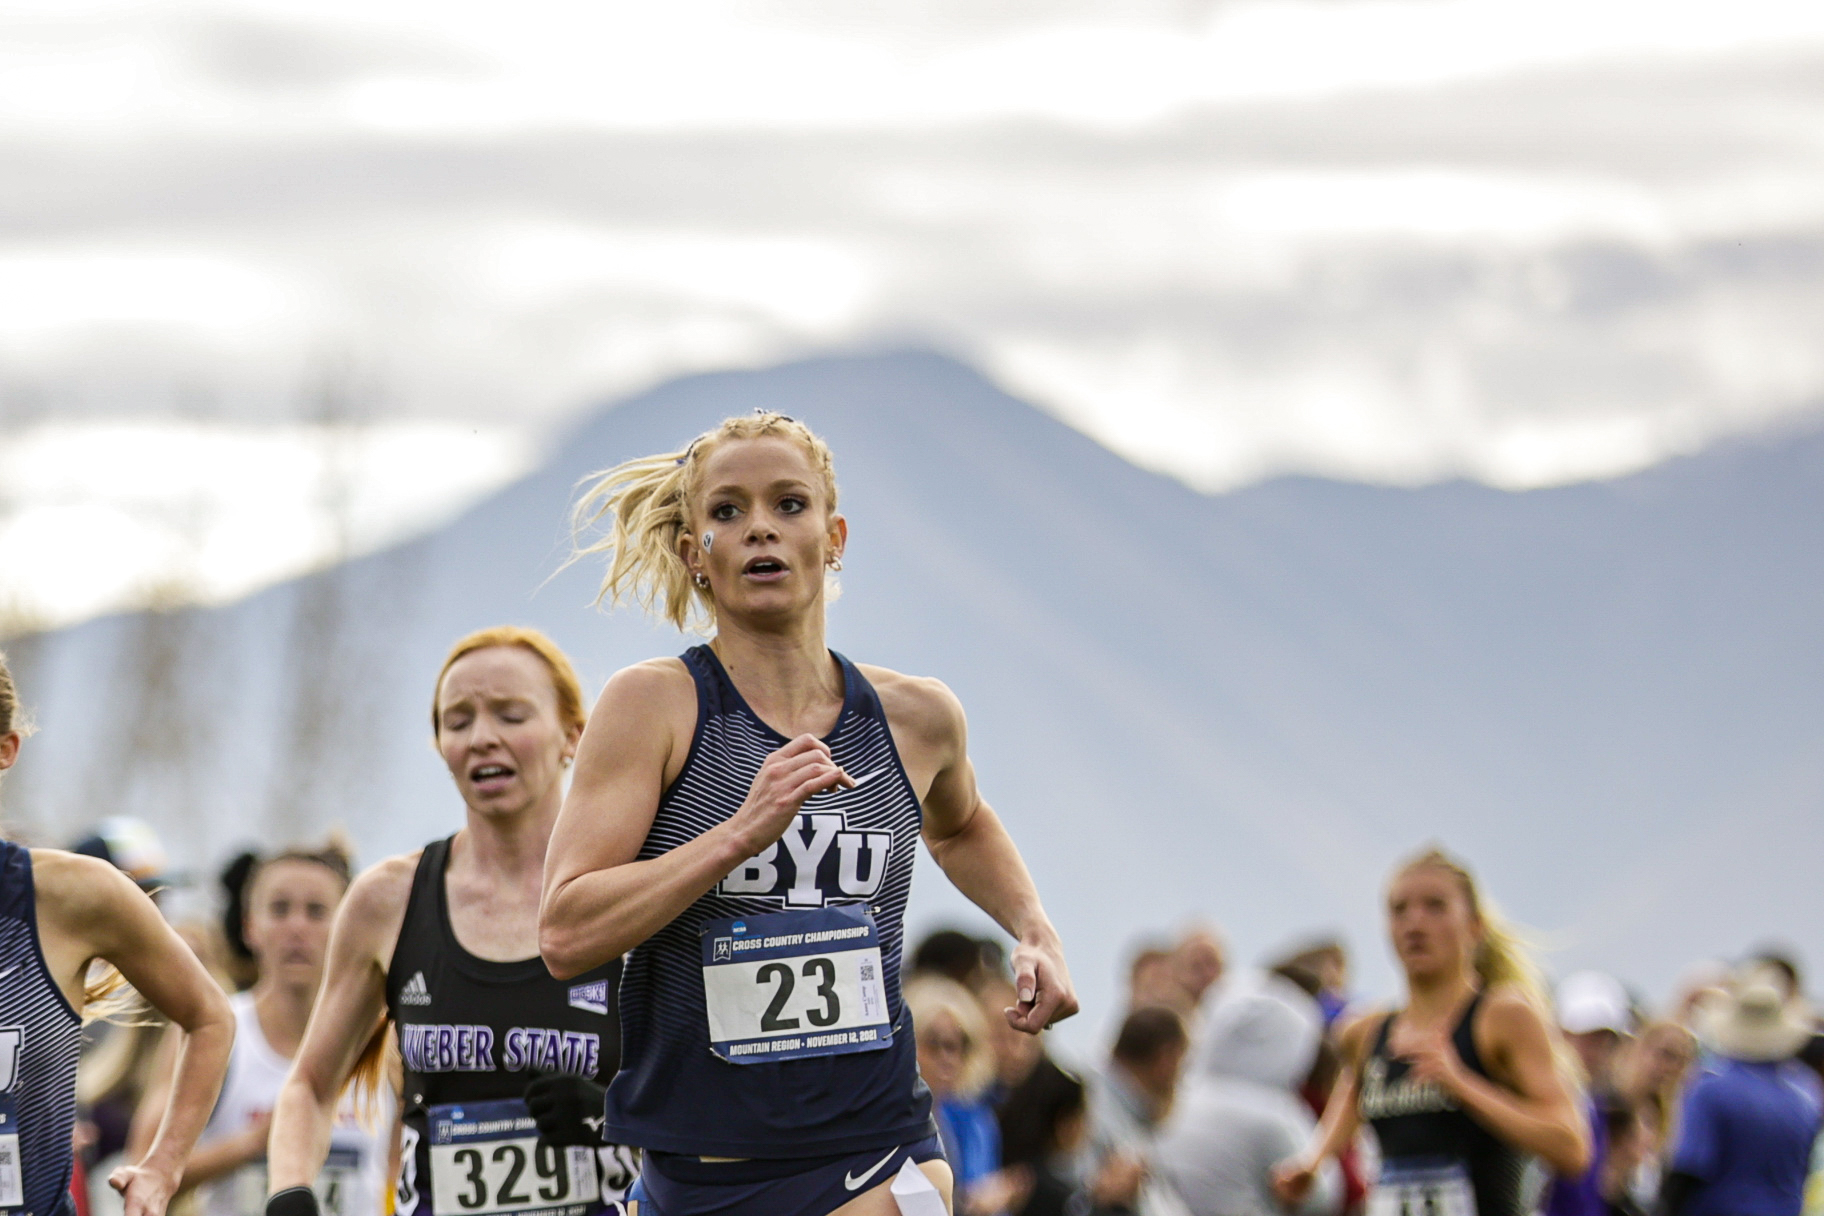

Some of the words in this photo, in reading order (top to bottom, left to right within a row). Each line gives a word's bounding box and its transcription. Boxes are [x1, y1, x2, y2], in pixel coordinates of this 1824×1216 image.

[720, 813, 892, 907] BYU
[732, 938, 762, 951] CROSS
[763, 933, 804, 948] COUNTRY
[804, 925, 870, 944] CHAMPIONSHIPS
[756, 957, 841, 1033] 23
[402, 1023, 497, 1073] WEBER
[502, 1026, 601, 1081] STATE
[730, 1040, 771, 1057] MOUNTAIN
[771, 1037, 801, 1052] REGION
[806, 1031, 848, 1049] NOVEMBER
[859, 1028, 878, 1043] 2021
[478, 1119, 515, 1134] COUNTRY
[453, 1144, 570, 1209] 329
